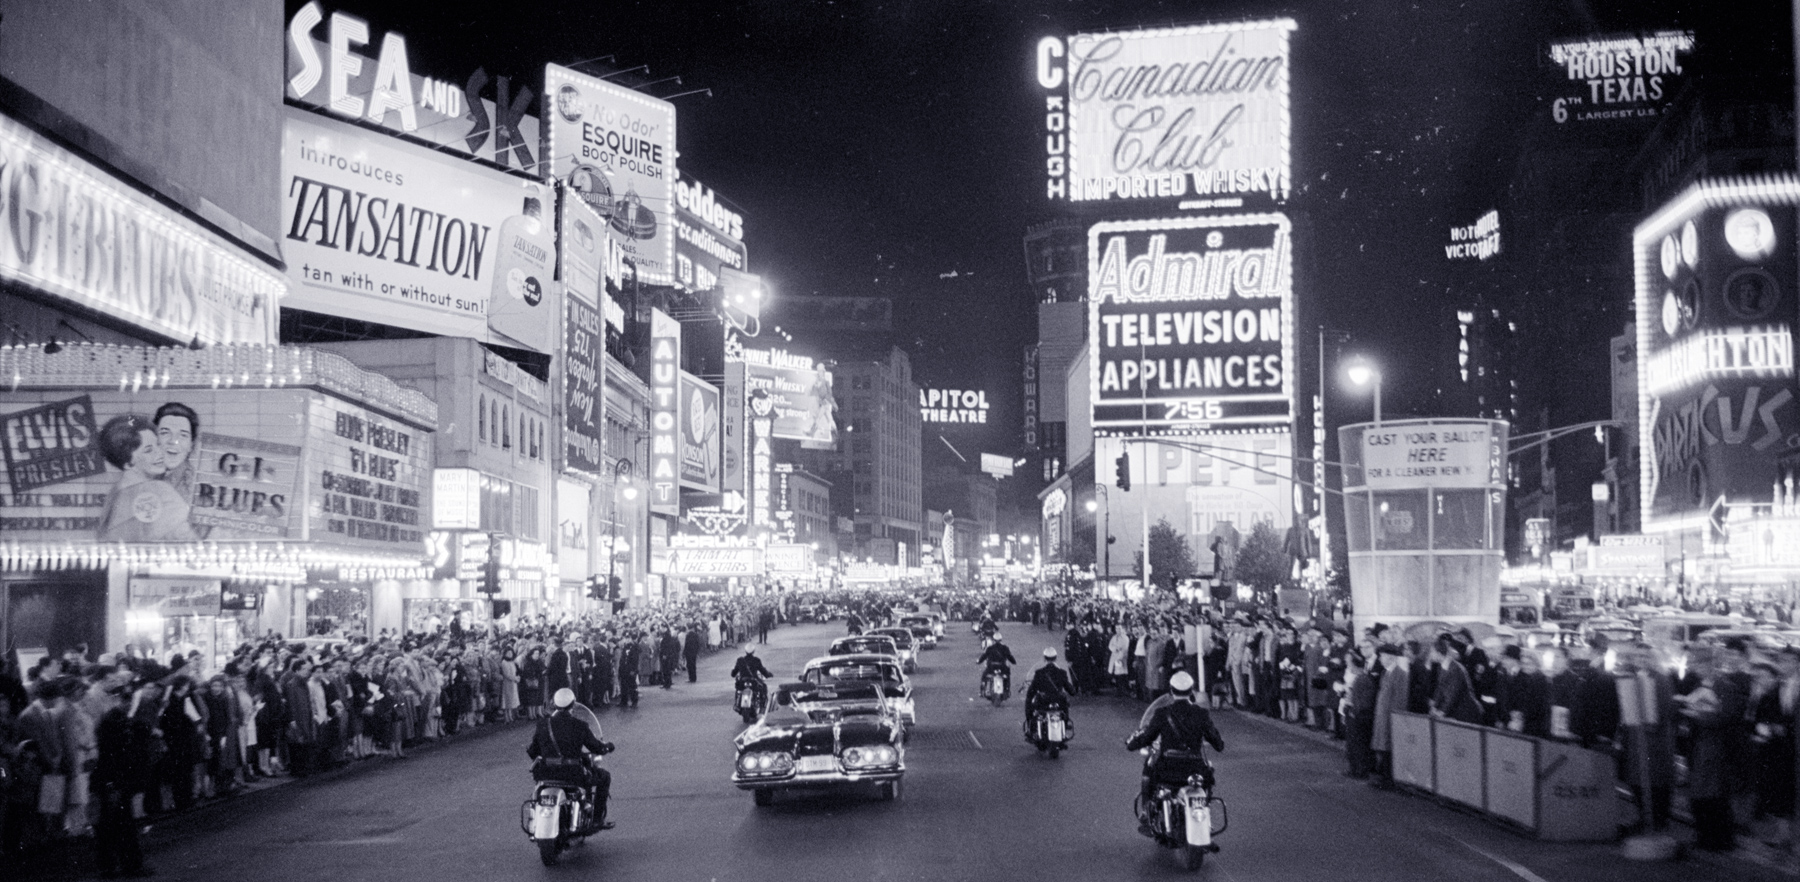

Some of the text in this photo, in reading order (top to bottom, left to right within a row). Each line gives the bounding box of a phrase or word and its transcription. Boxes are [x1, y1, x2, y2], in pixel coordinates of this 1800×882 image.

[289, 1, 418, 132] SEA
[421, 76, 461, 118] AND
[1068, 33, 1283, 103] Canadian
[1568, 46, 1683, 80] HOUSTON,
[1587, 76, 1663, 104] TEXAS
[1577, 110, 1634, 121] LARGEST
[582, 122, 663, 165] ESQUIRE
[1112, 103, 1245, 174] Club
[301, 141, 405, 186] introduces
[582, 145, 663, 180] BOOT POLISH
[1078, 166, 1281, 201] IMPORTED WHISKY
[676, 181, 744, 240] edders
[286, 175, 491, 281] TANSATION
[513, 235, 548, 263] TANSATION
[1445, 243, 1479, 260] VICTO
[1092, 230, 1291, 304] Admiral
[303, 263, 485, 313] tan with or without sun!
[1102, 308, 1280, 347] TELEVISION
[771, 347, 814, 370] WALKER
[1101, 354, 1282, 391] APPLIANCES
[920, 388, 990, 410] APITOL
[1164, 401, 1223, 420] 7:56
[7, 403, 91, 463] ELVIS
[654, 339, 676, 501] AUTOMAT
[920, 409, 987, 424] THEATRE
[681, 432, 704, 463] RONSON
[1368, 430, 1485, 447] CAST YOUR BALLOT
[1407, 447, 1448, 463] HERE
[14, 451, 99, 485] PRESLEY
[440, 473, 463, 482] MARY
[752, 419, 772, 526] WARNER
[1158, 440, 1278, 487] PEPE
[1368, 467, 1383, 478] FOR
[1385, 467, 1392, 477] A
[1395, 465, 1437, 478] CLEANER
[1440, 465, 1460, 476] NEW
[198, 482, 286, 518] BLUES
[436, 484, 466, 493] MARTIN
[339, 567, 437, 580] RESTAURANT
[683, 562, 749, 572] THE STARS
